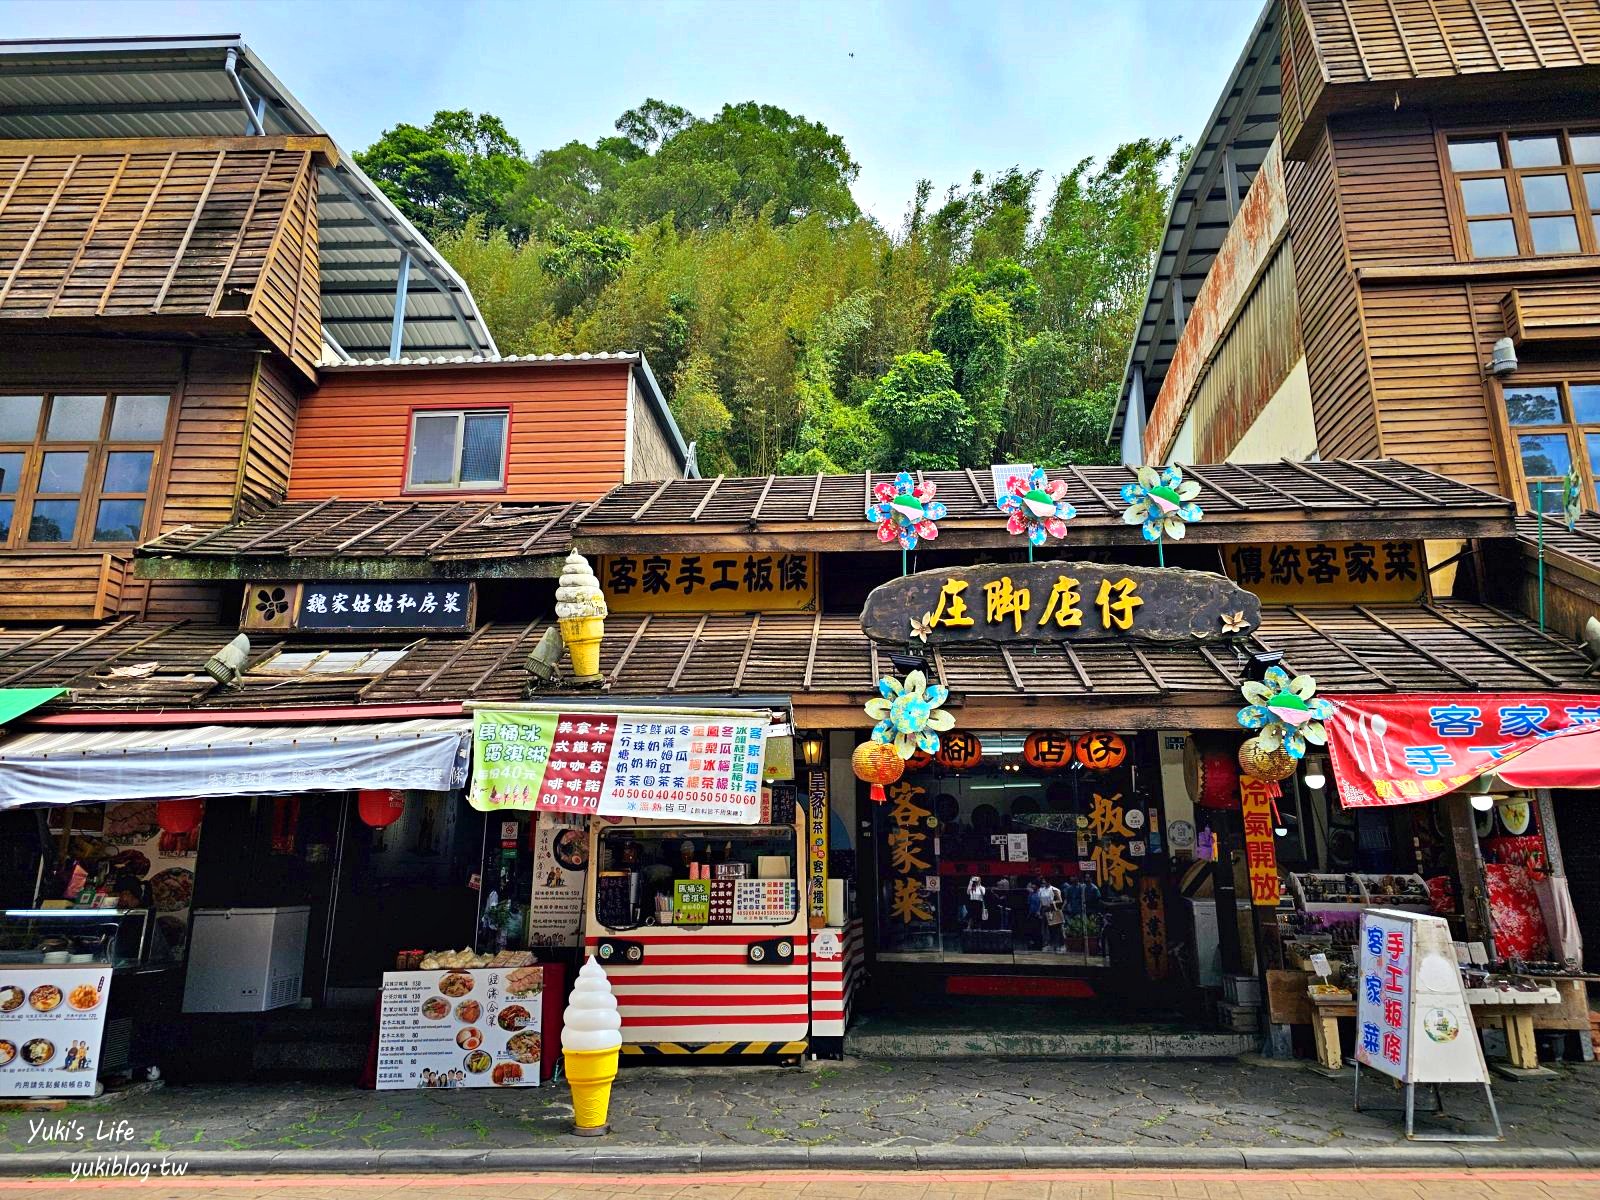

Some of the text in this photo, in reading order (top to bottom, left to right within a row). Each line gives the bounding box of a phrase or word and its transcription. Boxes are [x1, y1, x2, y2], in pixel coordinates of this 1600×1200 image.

[607, 554, 809, 595] 客家手工板條
[1231, 542, 1417, 585] 傳統客家菜
[305, 592, 461, 614] 魏家姑姑私房菜
[930, 575, 1145, 633] 庄脚店仔
[478, 722, 542, 742] 馬桶冰
[484, 742, 548, 763] 霜淇淋
[548, 721, 573, 790] 美式咖啡
[566, 722, 592, 792] 拿鐵咖啡
[585, 722, 609, 793] 卡布奇諾
[628, 724, 648, 787] 珍珠奶茶
[673, 725, 691, 788] 冬瓜茶
[744, 727, 762, 793] 客家擂茶
[542, 793, 597, 808] 60 70 70
[612, 788, 756, 805] 40 50 60 40 40 50 50 50 50 60
[888, 780, 934, 925] 客家菜
[1240, 778, 1279, 901] 冷氣開放
[1362, 924, 1384, 1056] 客家菜
